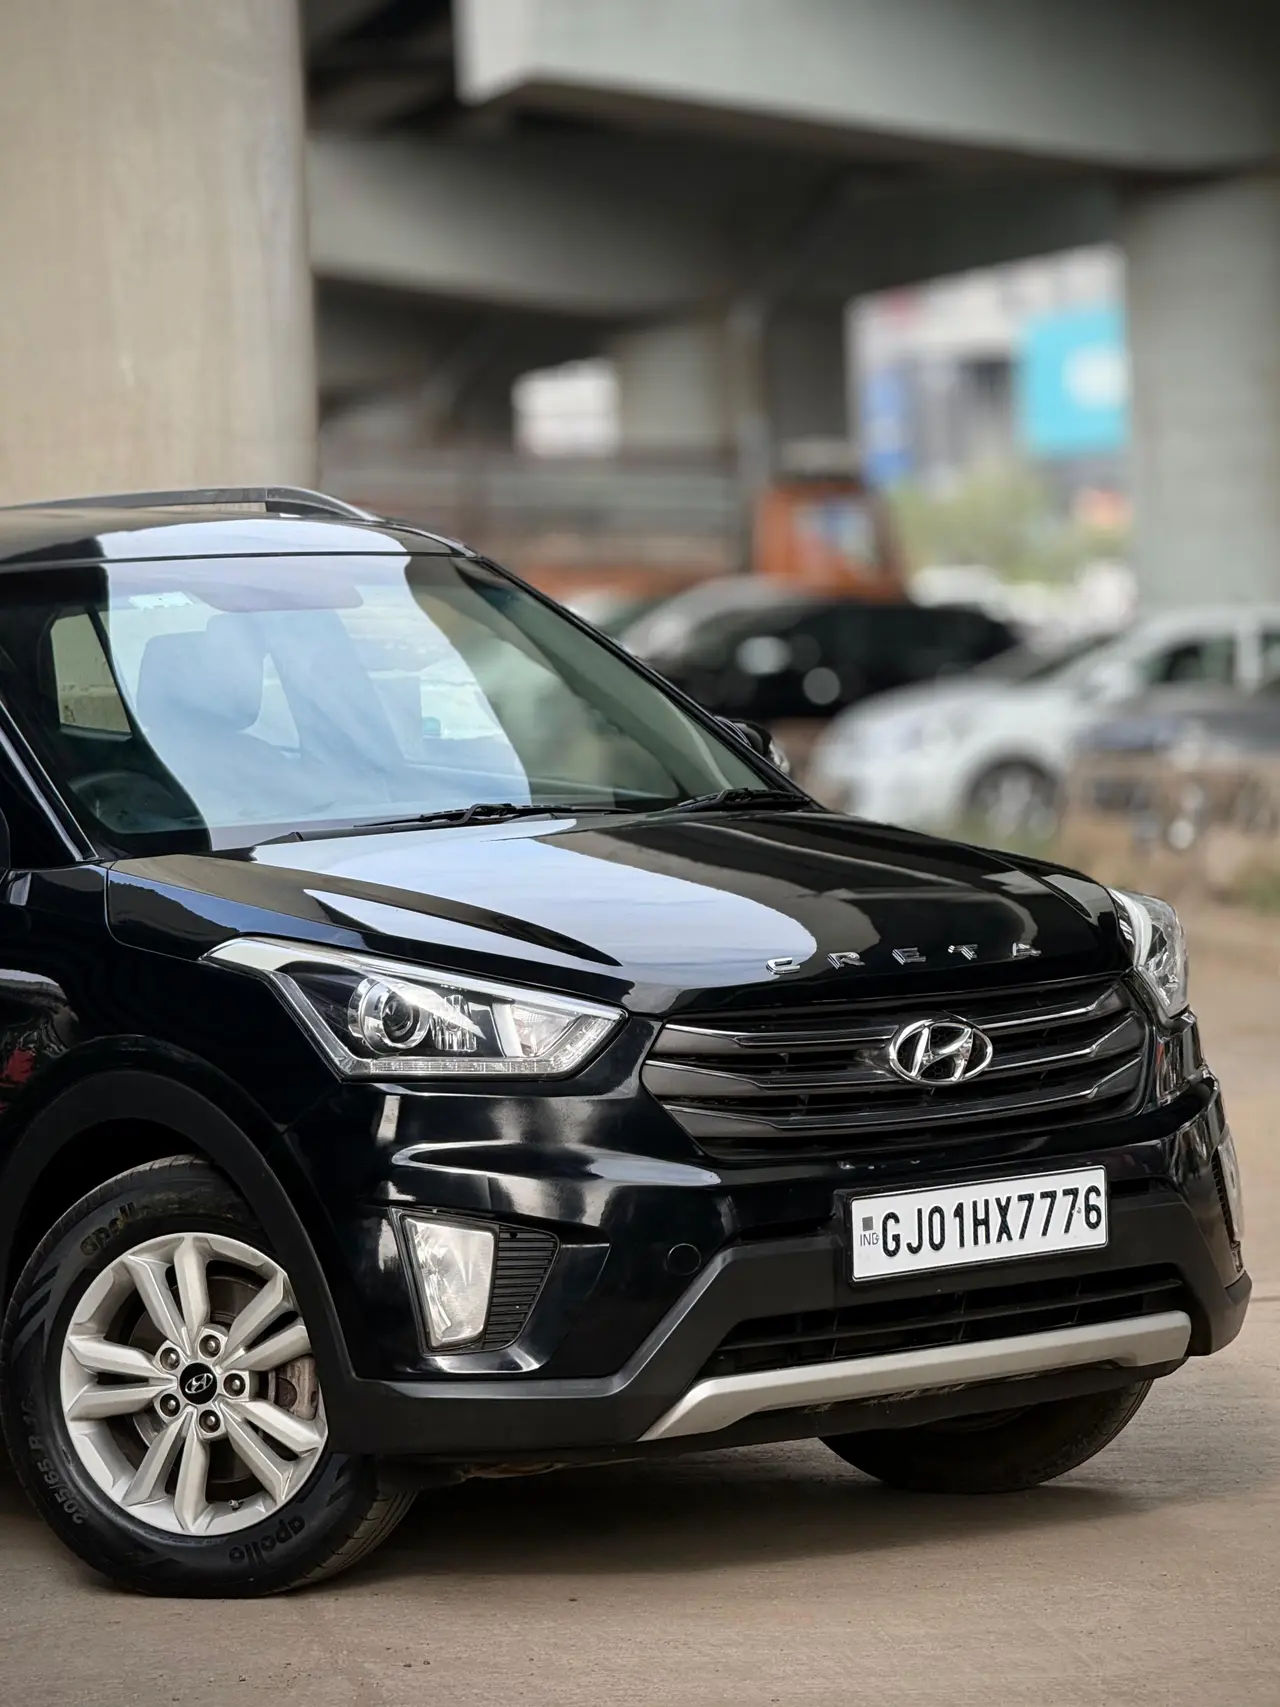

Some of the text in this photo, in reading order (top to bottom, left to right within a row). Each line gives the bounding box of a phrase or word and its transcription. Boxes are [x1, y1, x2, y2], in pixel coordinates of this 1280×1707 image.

[766, 942, 1042, 974] CRETA
[881, 1185, 1103, 1258] GJ01HX7776
[228, 1515, 306, 1569] apollo
